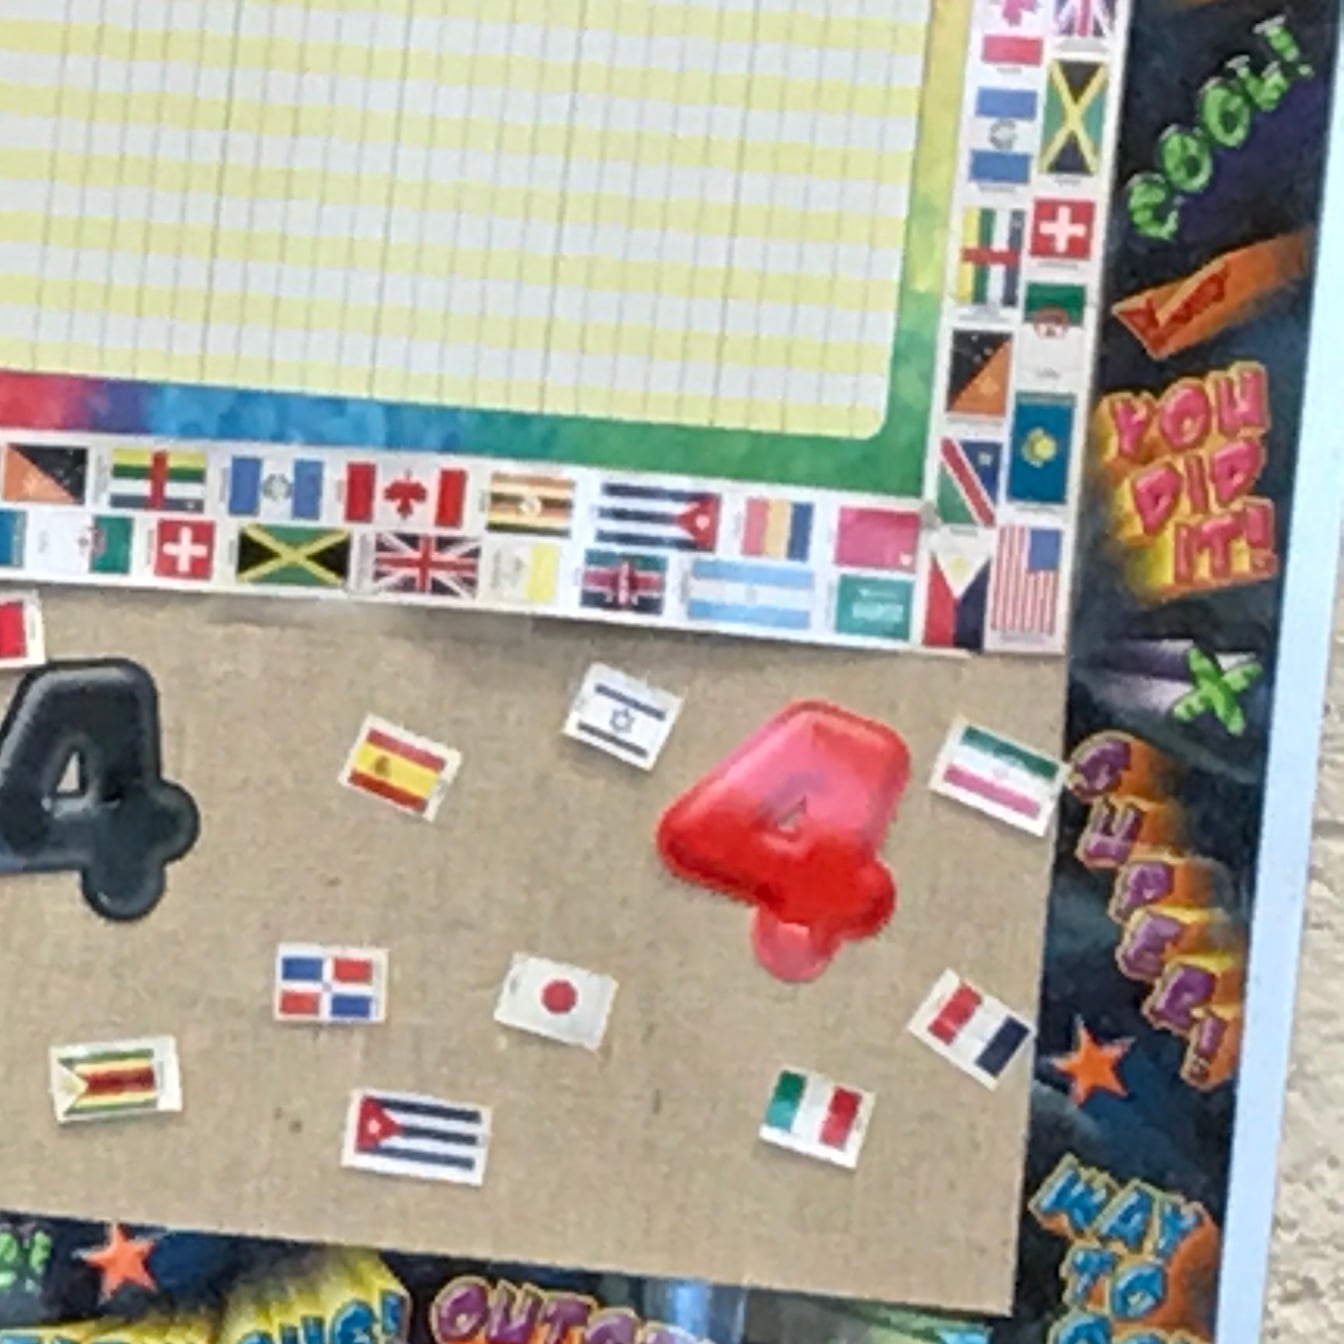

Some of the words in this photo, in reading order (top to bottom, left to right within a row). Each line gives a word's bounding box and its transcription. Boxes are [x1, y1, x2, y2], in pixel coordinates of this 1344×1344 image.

[1126, 14, 1315, 241] COOL!
[1105, 363, 1270, 464] YOU
[1128, 437, 1266, 540] DID
[1173, 500, 1277, 585] IT!
[656, 699, 912, 984] 4
[1064, 728, 1230, 1092] SUPER!
[1029, 1153, 1205, 1260] WAY
[1061, 1240, 1169, 1319] TO
